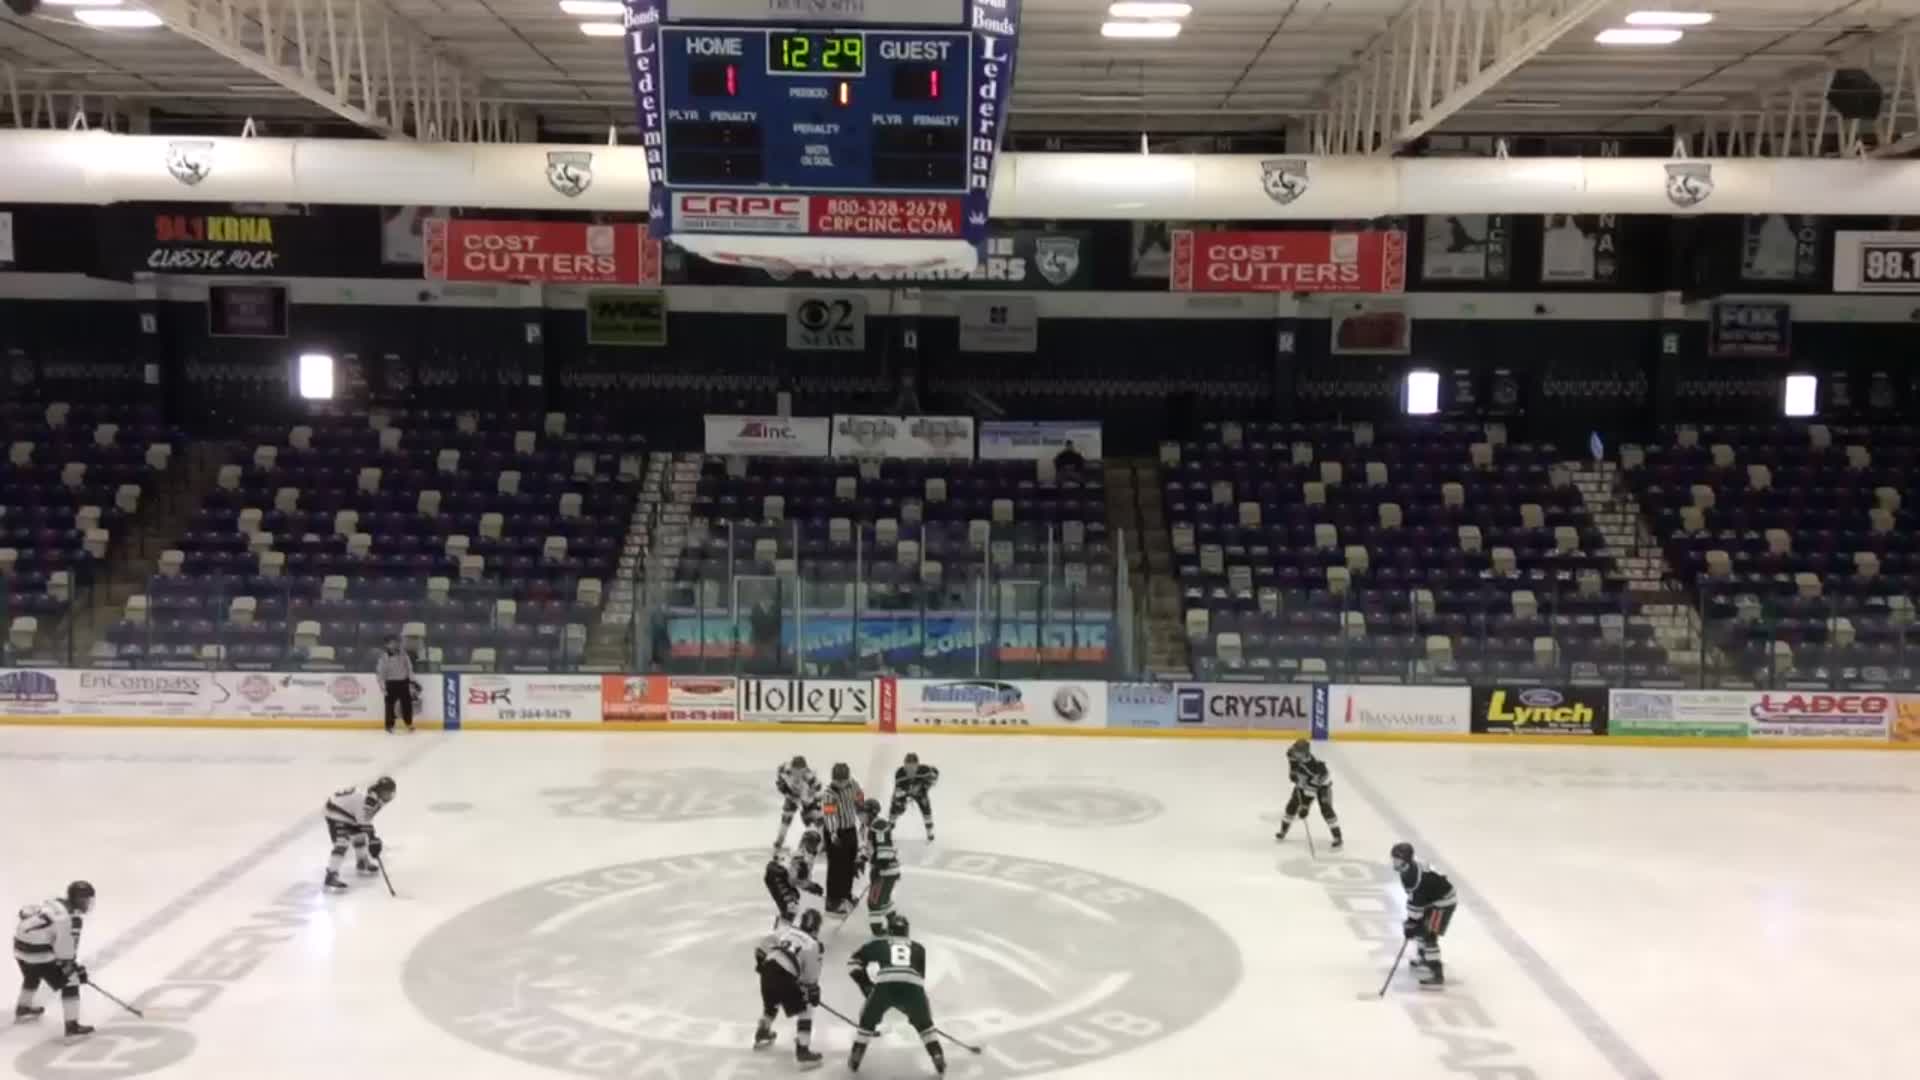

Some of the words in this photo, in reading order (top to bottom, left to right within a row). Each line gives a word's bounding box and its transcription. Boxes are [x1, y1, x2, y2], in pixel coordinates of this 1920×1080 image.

[972, 5, 1016, 35] Bonds
[686, 37, 743, 55] HOME
[879, 41, 951, 60] GUEST
[725, 64, 737, 96] 1
[930, 70, 938, 97] 1
[631, 30, 663, 183] Lederman
[710, 111, 757, 121] PENALTY
[971, 35, 1009, 188] Lederman
[913, 115, 960, 126] PENALTY
[681, 196, 801, 215] CRPC
[827, 199, 948, 216] 800-328-2679
[818, 215, 954, 234] CRPCINC.COM
[463, 235, 540, 251] COST
[147, 249, 224, 270] CLASSIC
[463, 252, 617, 275] CUTTERS
[1207, 245, 1284, 262] COST
[1206, 263, 1360, 283] CUTTERS
[79, 672, 200, 691] EnCompass
[744, 679, 867, 720] Holley's
[1209, 695, 1308, 718] CRYSTAL
[1487, 690, 1594, 724] Lynch
